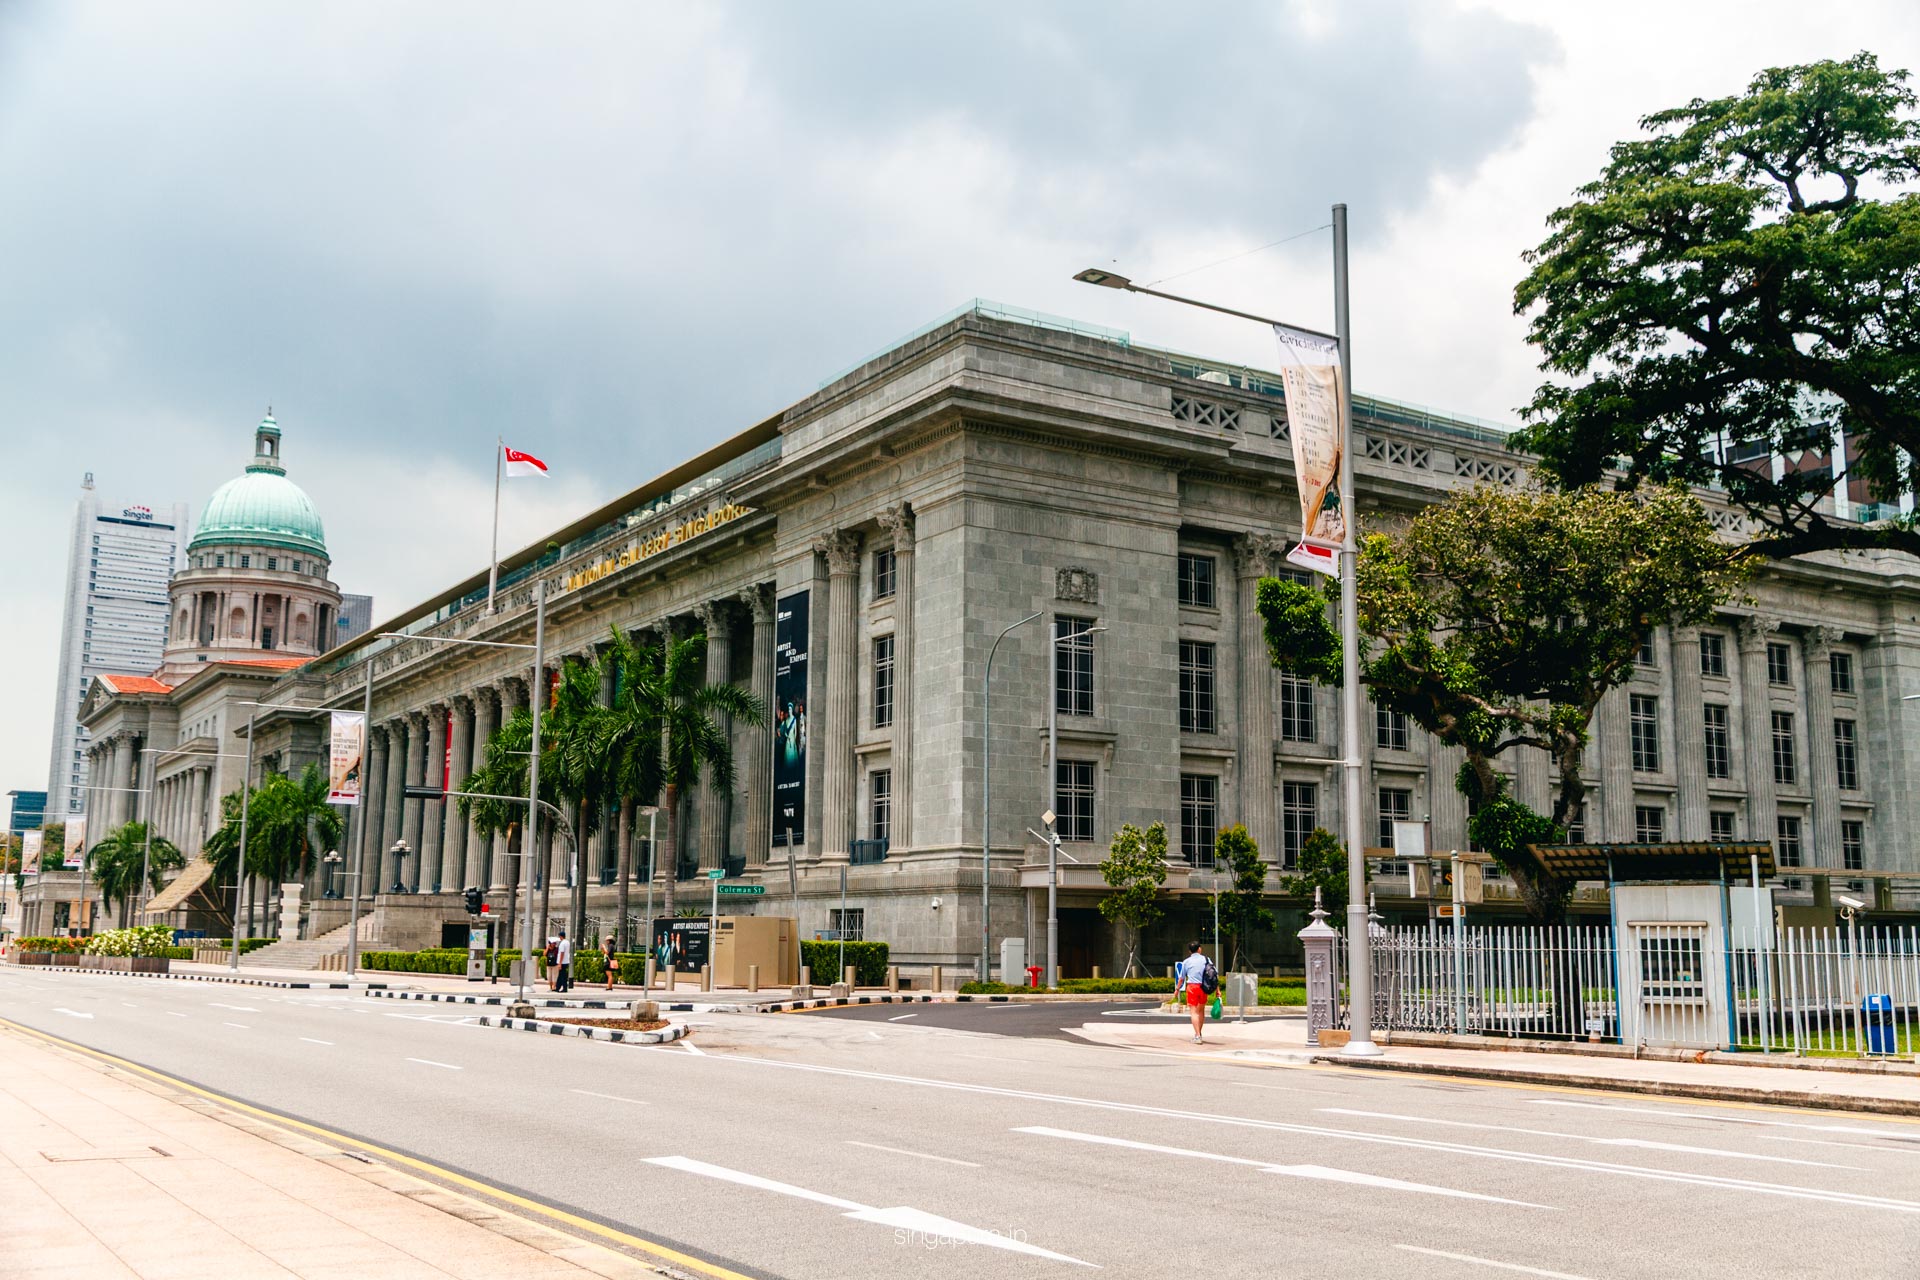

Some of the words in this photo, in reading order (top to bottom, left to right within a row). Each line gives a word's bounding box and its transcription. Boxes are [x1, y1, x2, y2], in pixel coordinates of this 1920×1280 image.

[123, 509, 153, 520] Singtel
[566, 558, 616, 592] NATIONAL
[619, 531, 671, 570] GALLERY
[777, 642, 791, 652] ARTIST
[785, 648, 797, 657] AND
[789, 652, 808, 664] EMPIRE
[1464, 875, 1481, 890] STOP
[753, 886, 761, 894] St
